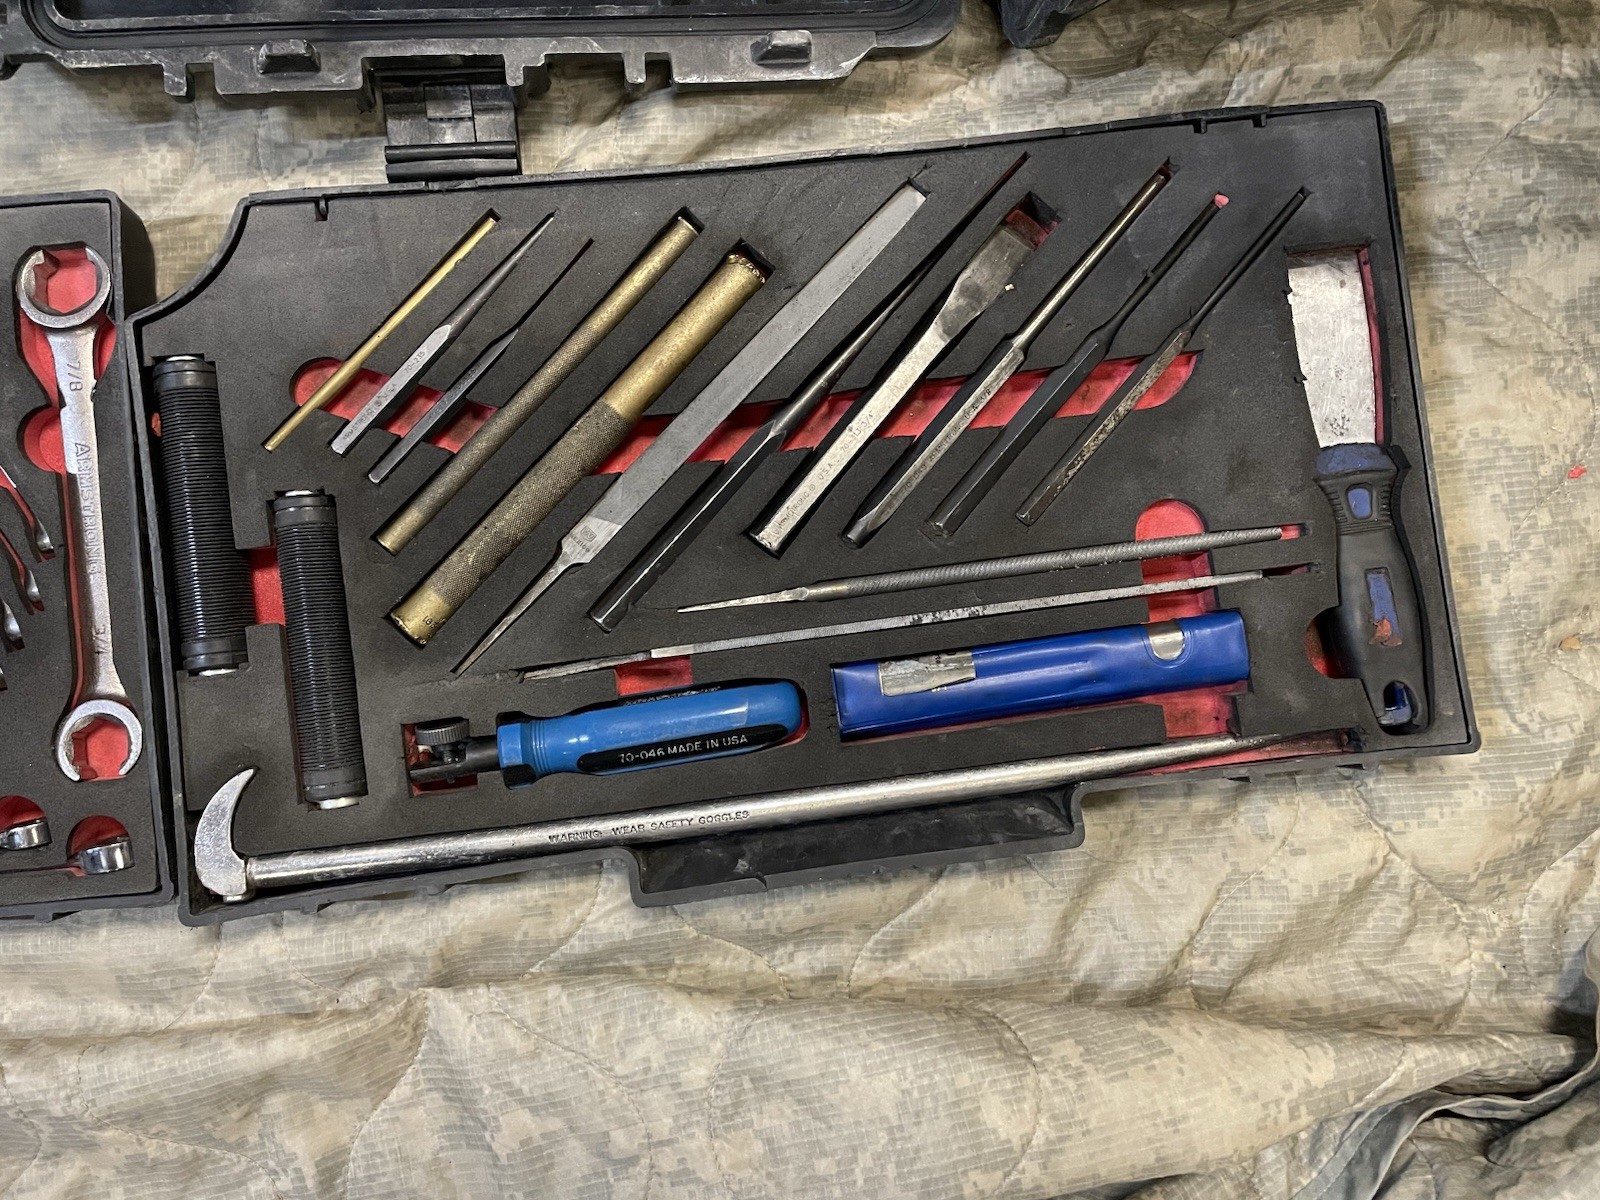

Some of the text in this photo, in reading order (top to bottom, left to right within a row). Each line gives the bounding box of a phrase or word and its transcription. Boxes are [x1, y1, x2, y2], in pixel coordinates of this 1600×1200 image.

[66, 360, 83, 392] 7/8
[75, 443, 102, 574] ARMSTRONG
[618, 734, 749, 763] 70-046 MADE IN USA
[612, 823, 645, 836] WEAR
[650, 817, 693, 831] SAFETY
[698, 810, 750, 825] GOGGLES
